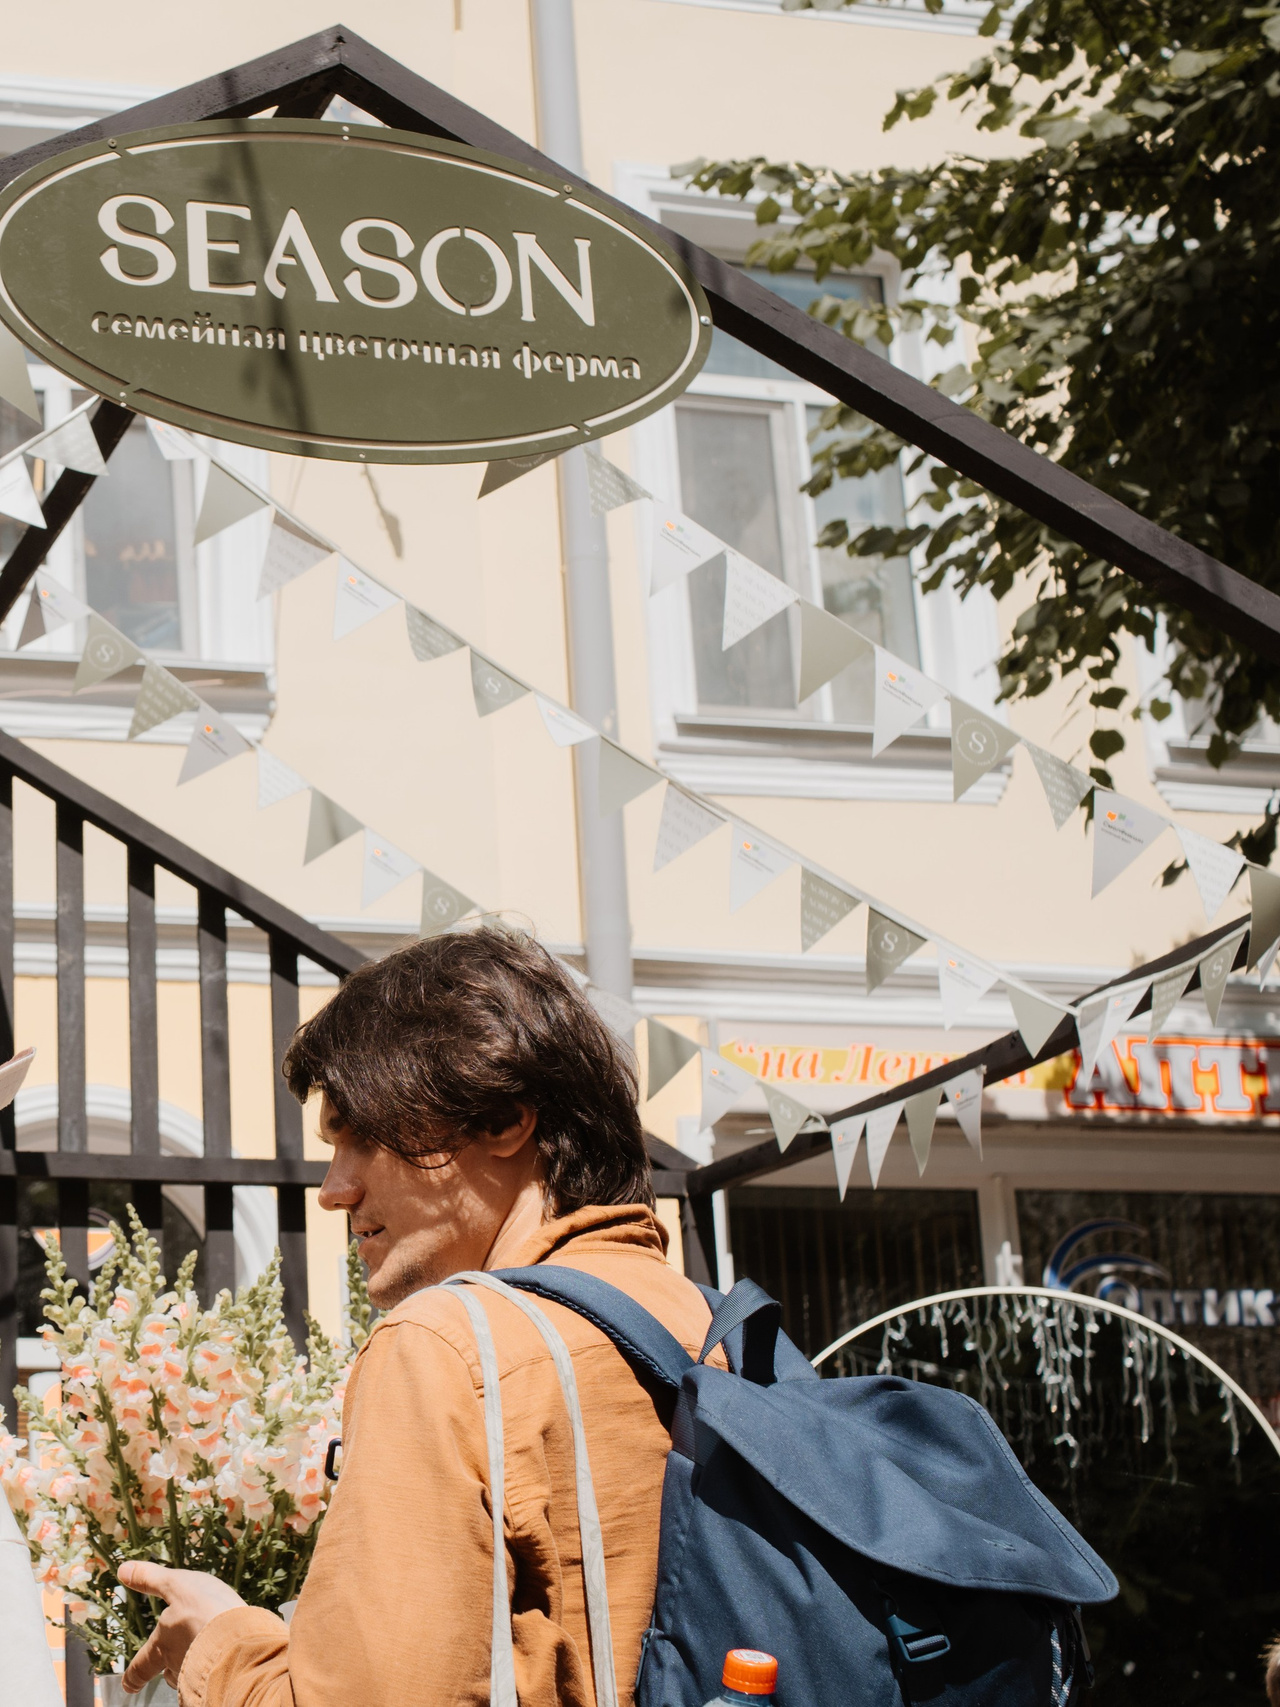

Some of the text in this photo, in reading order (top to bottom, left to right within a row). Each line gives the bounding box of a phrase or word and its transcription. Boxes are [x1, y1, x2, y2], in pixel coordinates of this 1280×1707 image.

[97, 193, 596, 327] SEASON
[90, 310, 642, 382] семейная цветочная ферма
[1065, 1038, 1280, 1112] АПТ
